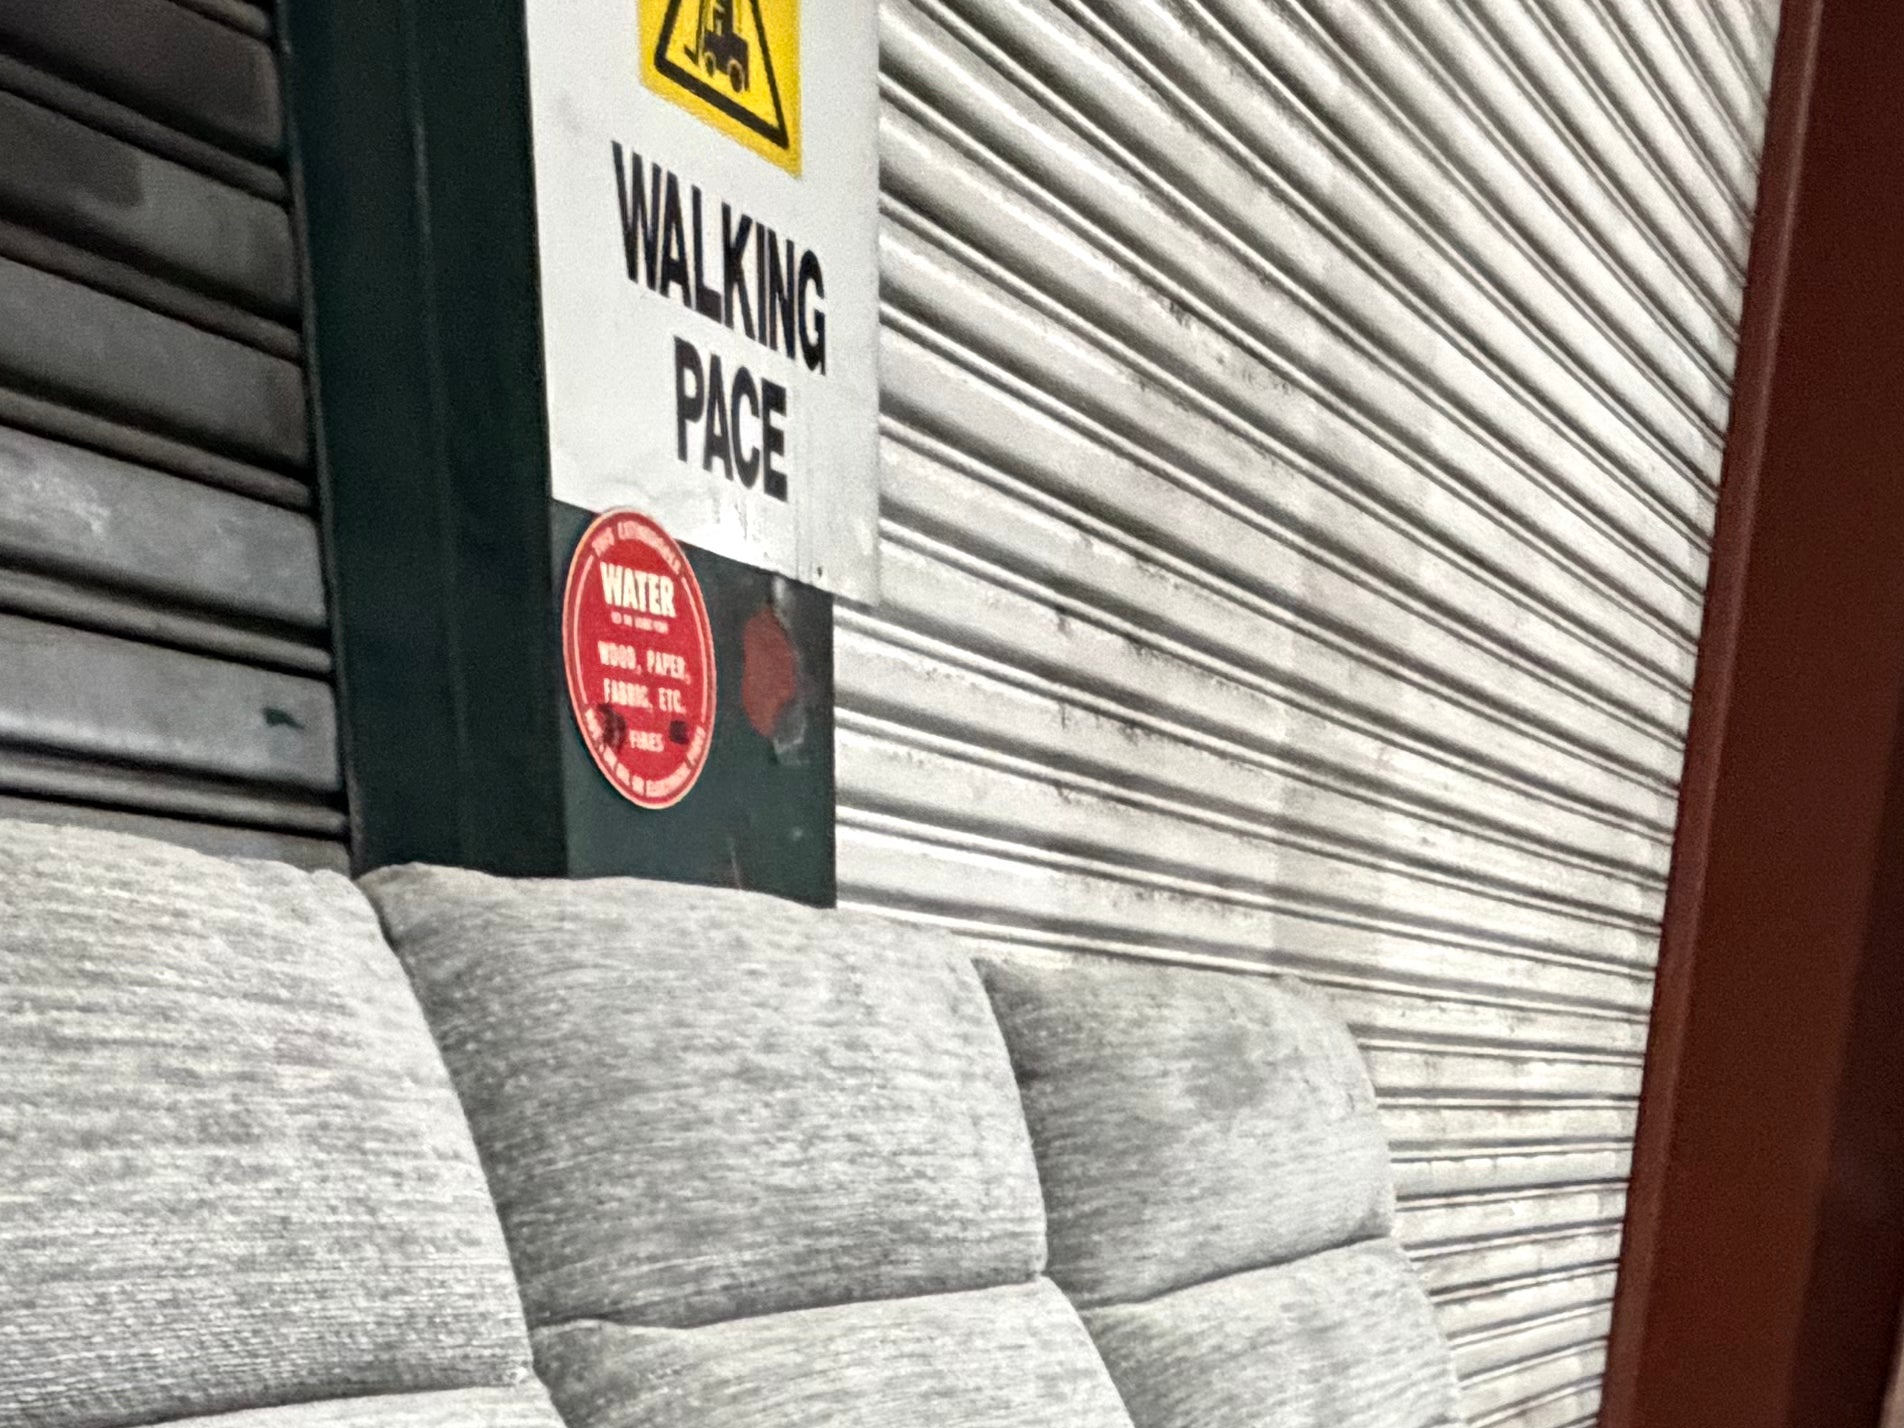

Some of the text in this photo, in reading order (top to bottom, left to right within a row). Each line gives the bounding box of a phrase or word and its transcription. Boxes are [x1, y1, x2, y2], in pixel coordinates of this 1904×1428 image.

[611, 140, 826, 376] WALKING
[674, 335, 788, 501] PACE
[599, 561, 677, 618] WATER
